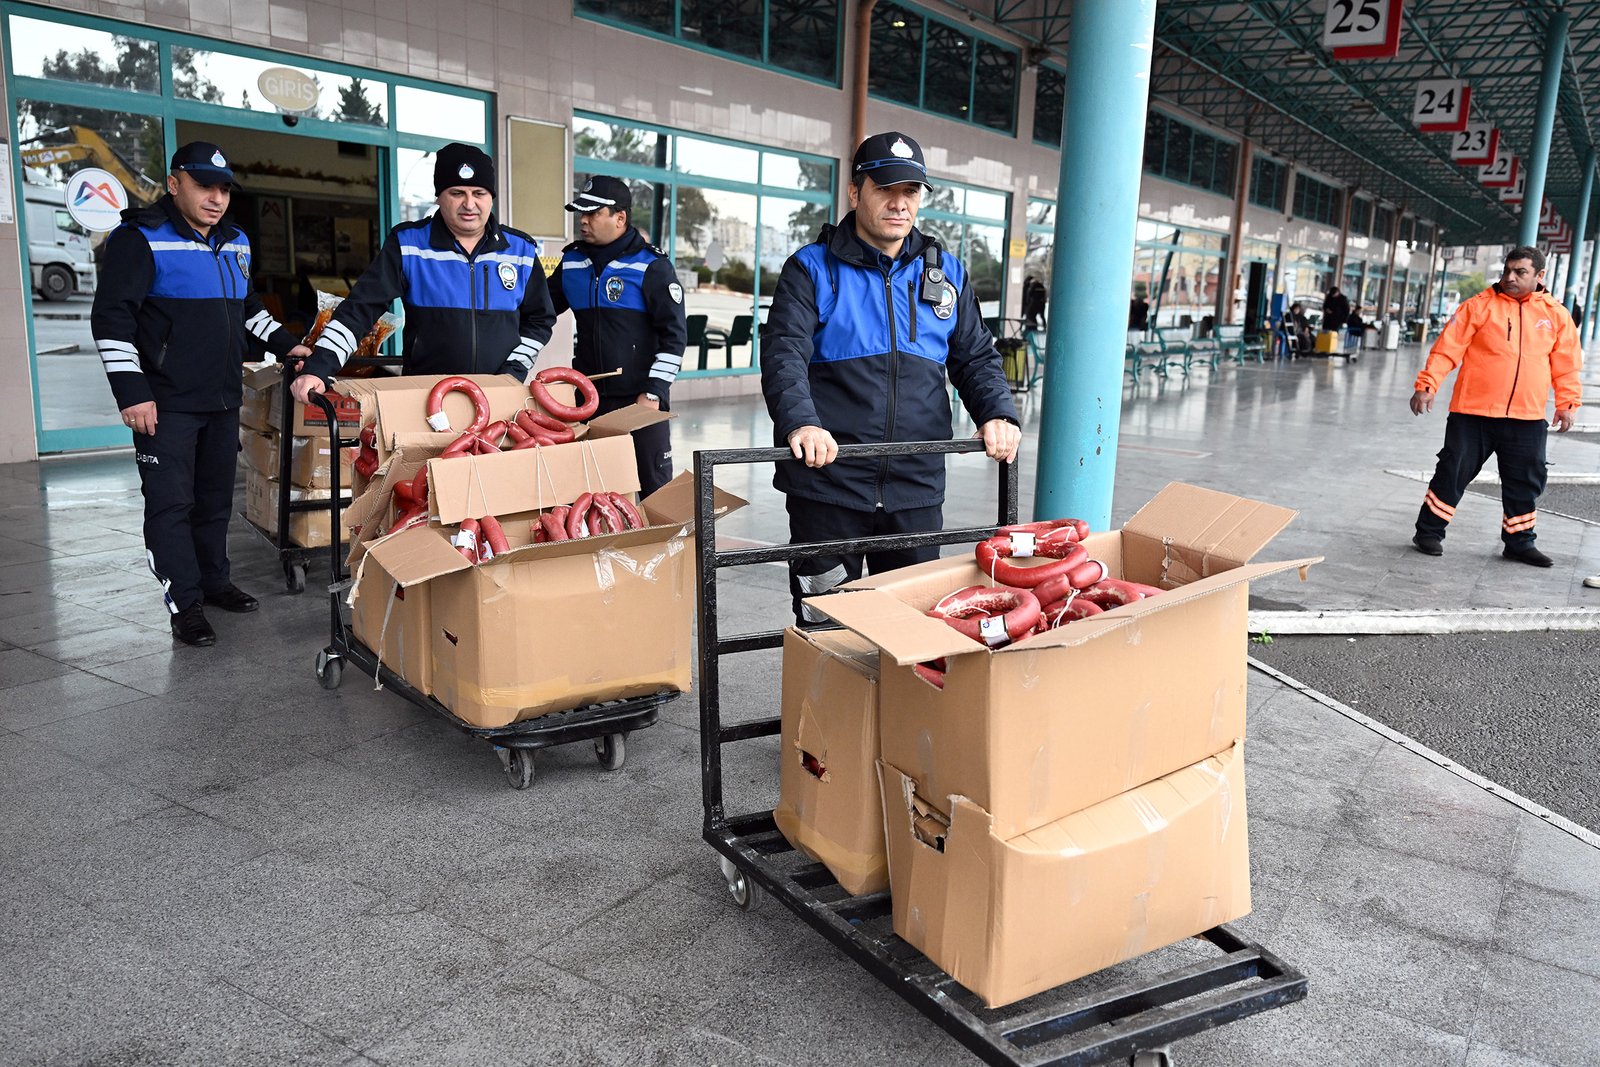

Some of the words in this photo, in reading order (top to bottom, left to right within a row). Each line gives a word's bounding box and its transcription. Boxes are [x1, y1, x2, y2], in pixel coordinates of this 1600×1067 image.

[1330, 0, 1380, 34] 25
[1419, 88, 1455, 114] 24
[1457, 129, 1486, 151] 23
[1483, 158, 1508, 175] 22
